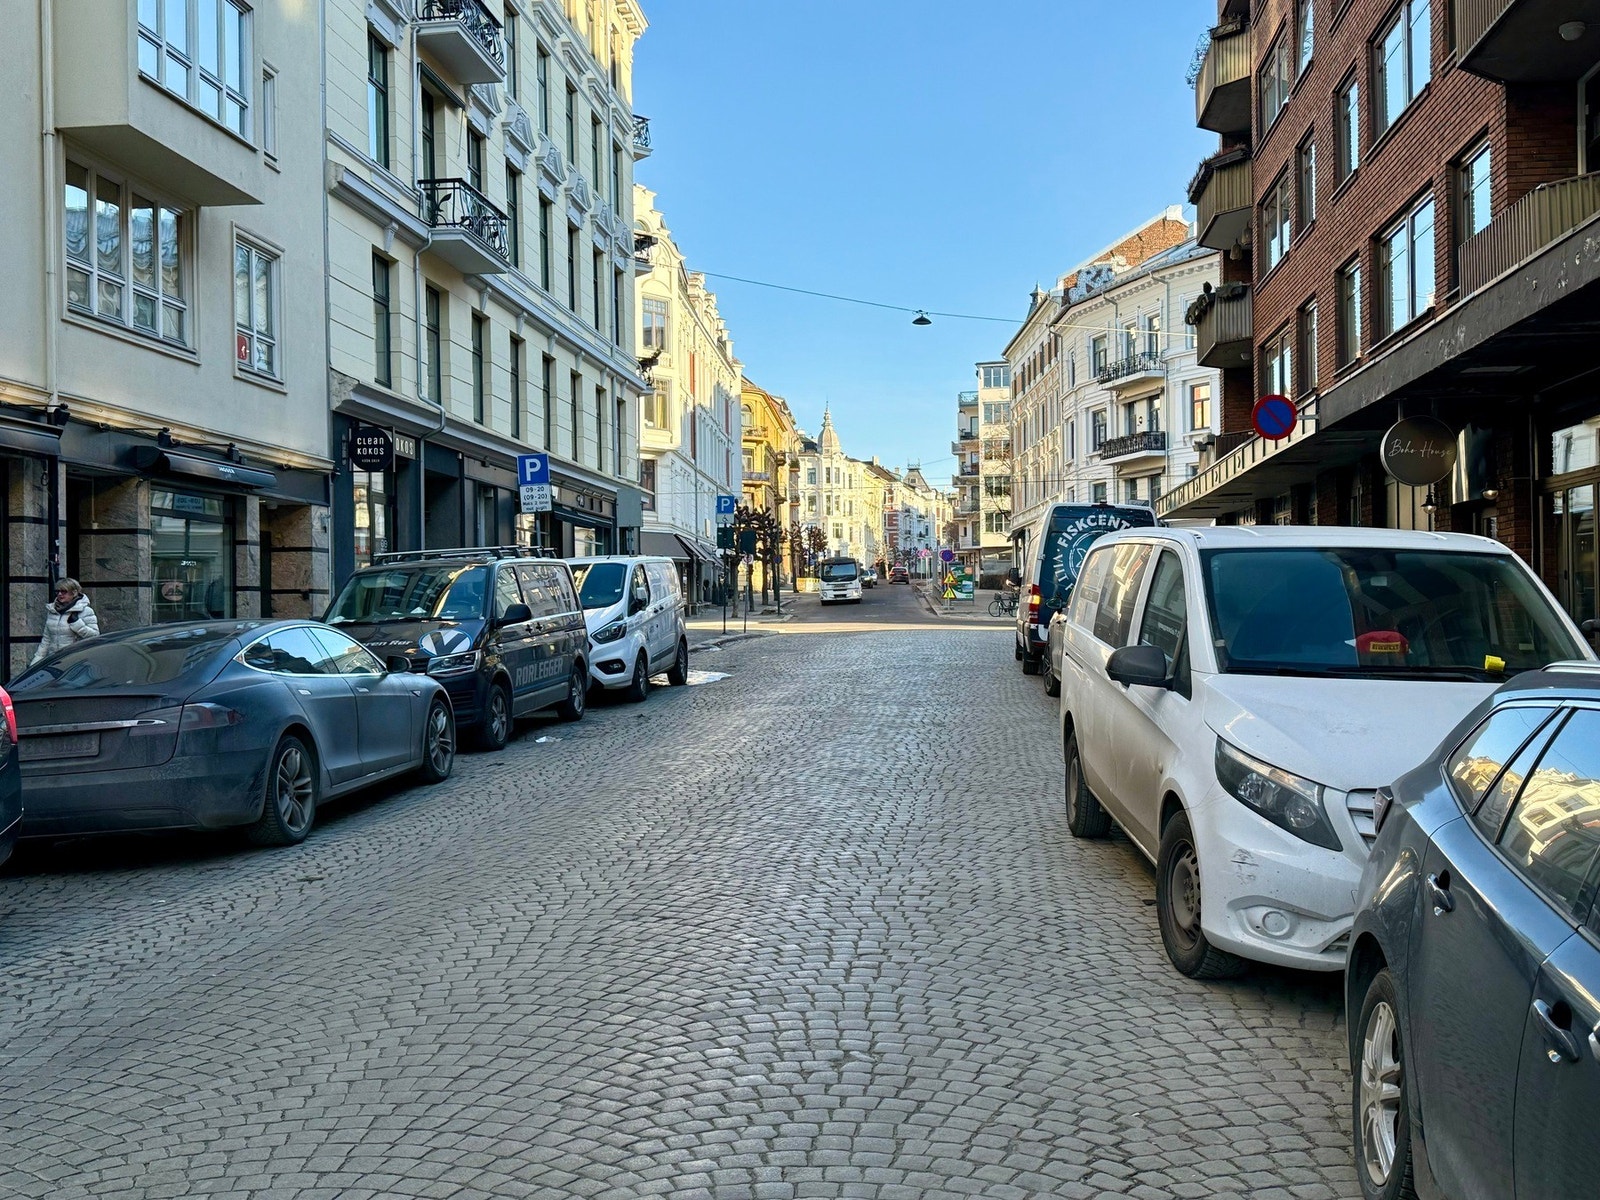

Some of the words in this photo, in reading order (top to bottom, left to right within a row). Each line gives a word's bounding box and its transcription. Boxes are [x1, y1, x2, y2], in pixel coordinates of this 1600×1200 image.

[357, 447, 384, 455] KOKOS
[395, 437, 413, 455] OKOS
[1388, 439, 1417, 457] Boho
[1420, 440, 1454, 458] House
[525, 458, 542, 482] P
[721, 498, 731, 512] P
[1057, 514, 1134, 548] FISKCENT
